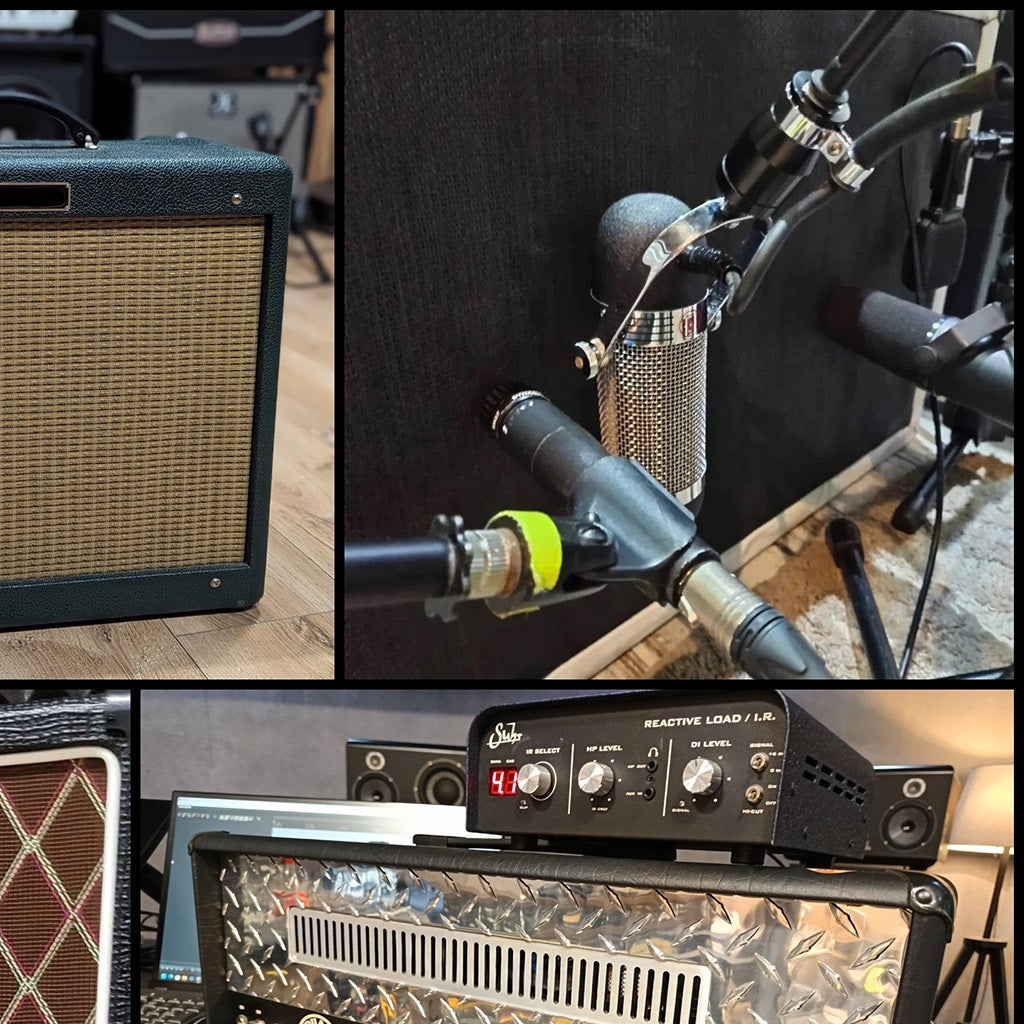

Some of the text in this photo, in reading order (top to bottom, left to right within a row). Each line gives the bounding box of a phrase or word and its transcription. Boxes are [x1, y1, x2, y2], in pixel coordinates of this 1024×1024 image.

[644, 716, 702, 728] REACTIVE
[706, 714, 742, 725] LOAD
[754, 711, 777, 722] I.R.
[599, 744, 623, 752] LEVEL
